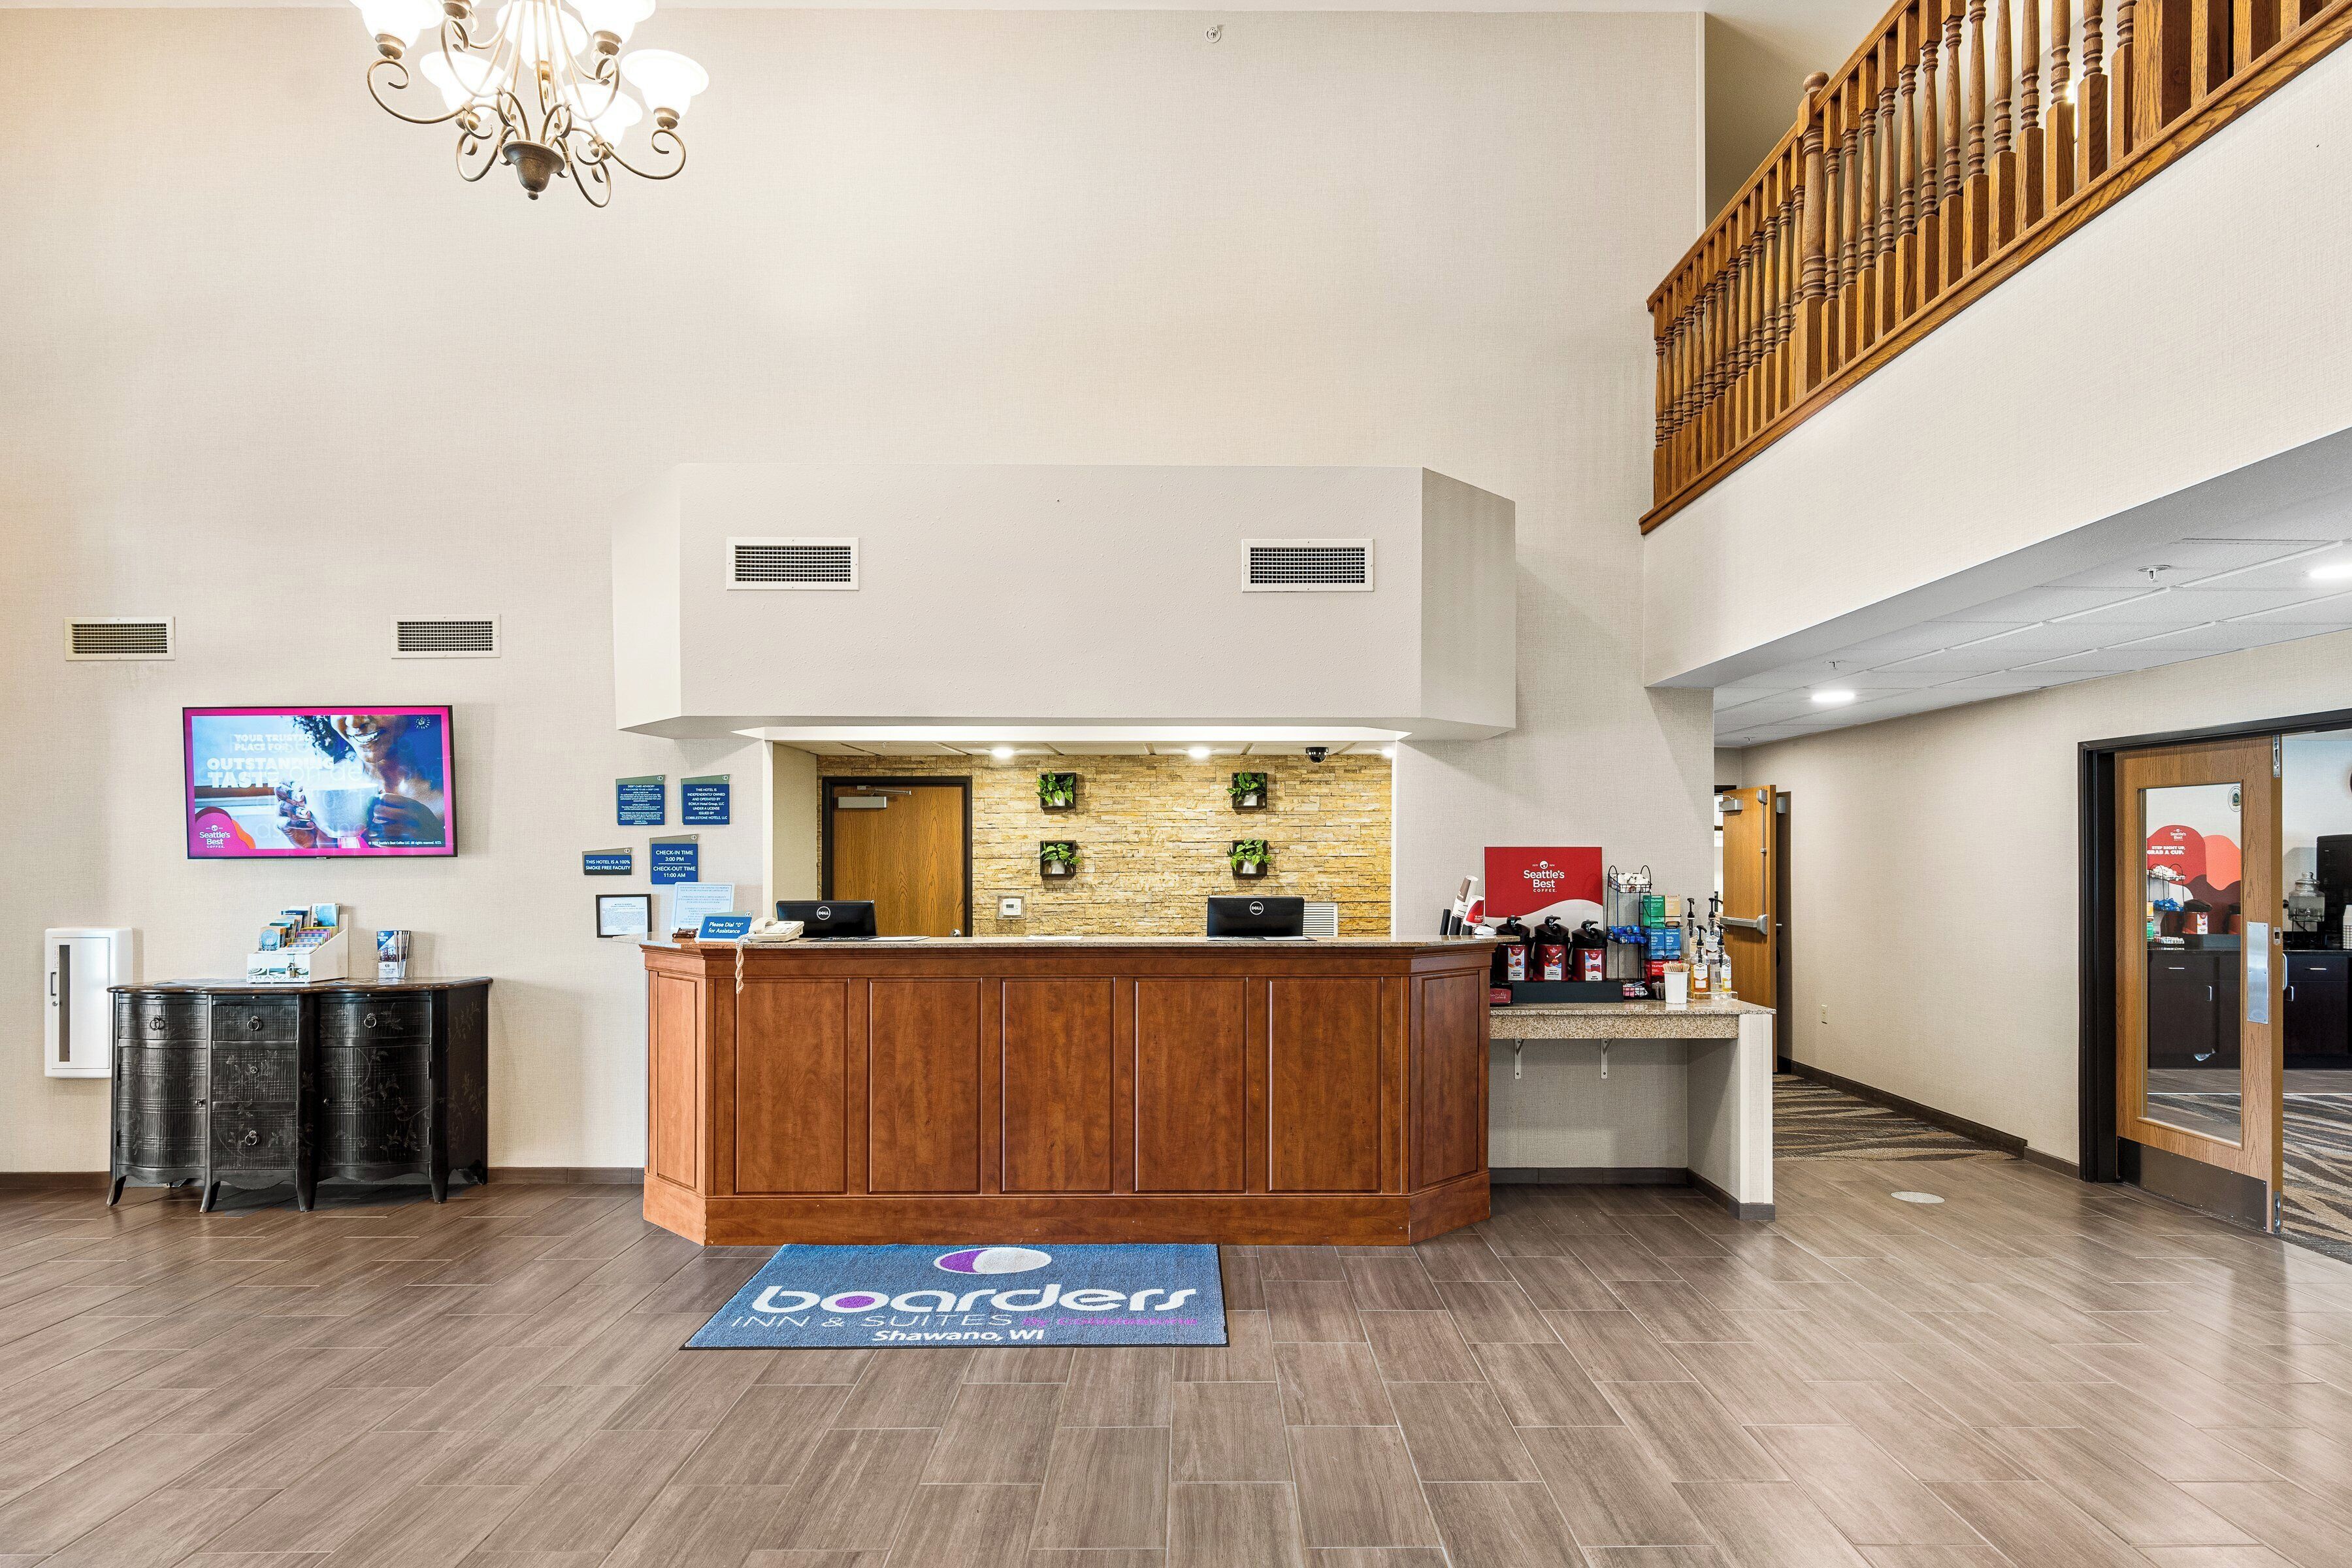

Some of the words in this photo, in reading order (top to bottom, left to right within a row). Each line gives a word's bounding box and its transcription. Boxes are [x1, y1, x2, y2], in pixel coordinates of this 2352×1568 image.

[234, 743, 265, 751] PLACE
[206, 757, 335, 770] OUTSTANDING
[207, 771, 280, 788] TASTE
[1524, 870, 1565, 879] Seattle's
[1533, 879, 1555, 888] Best
[752, 1284, 1196, 1313] boarders
[731, 1316, 811, 1327] INN
[821, 1317, 844, 1327] &
[860, 1315, 1012, 1326] SUITES
[872, 1330, 1003, 1341] Shawano,
[1011, 1330, 1044, 1340] WI
